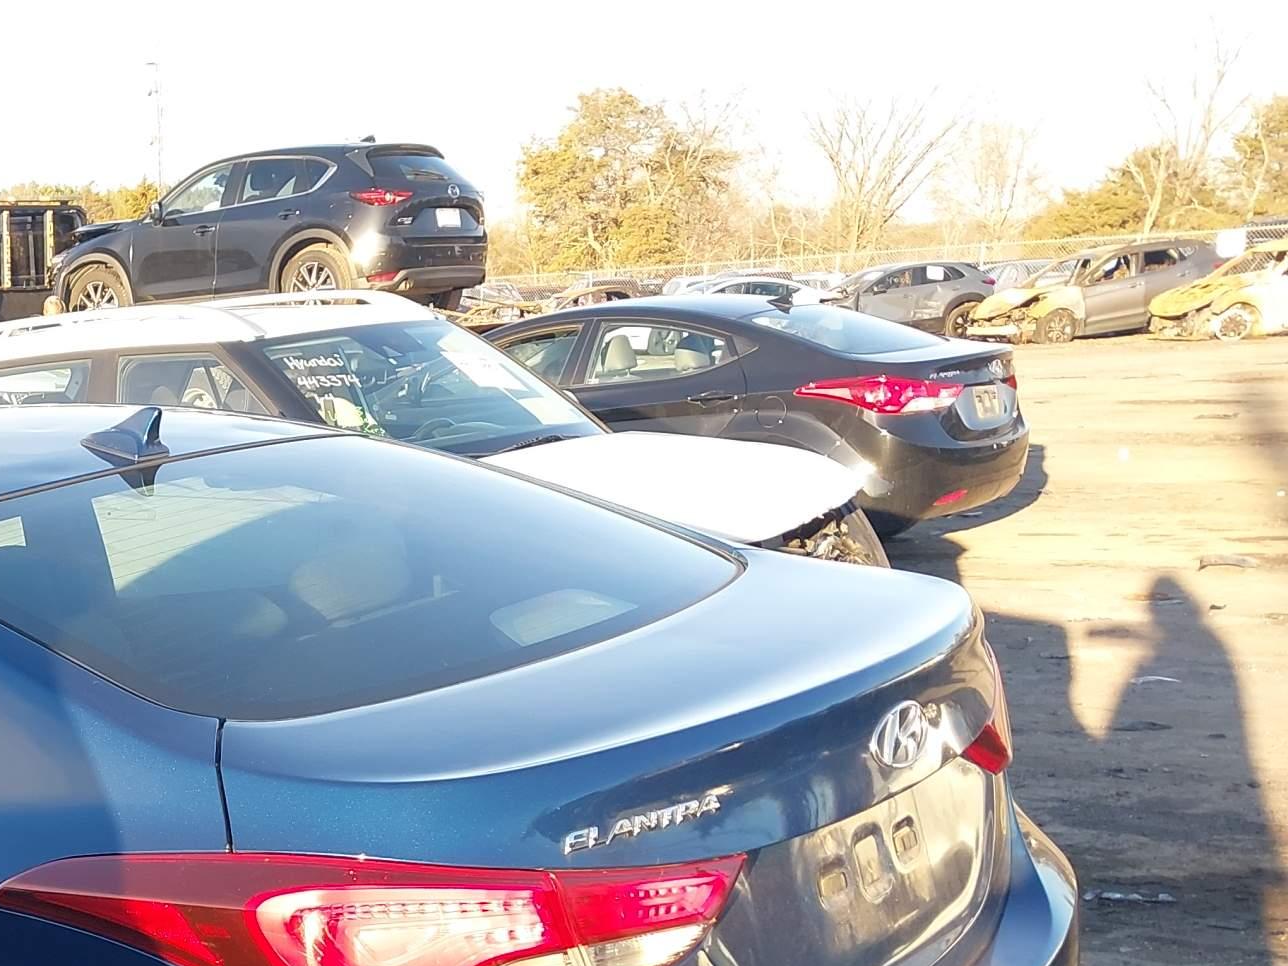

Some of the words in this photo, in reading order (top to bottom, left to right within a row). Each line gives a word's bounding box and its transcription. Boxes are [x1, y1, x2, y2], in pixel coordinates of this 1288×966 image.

[283, 354, 344, 370] Hyundai
[297, 374, 362, 388] 443374
[564, 794, 721, 856] ELANTRA
